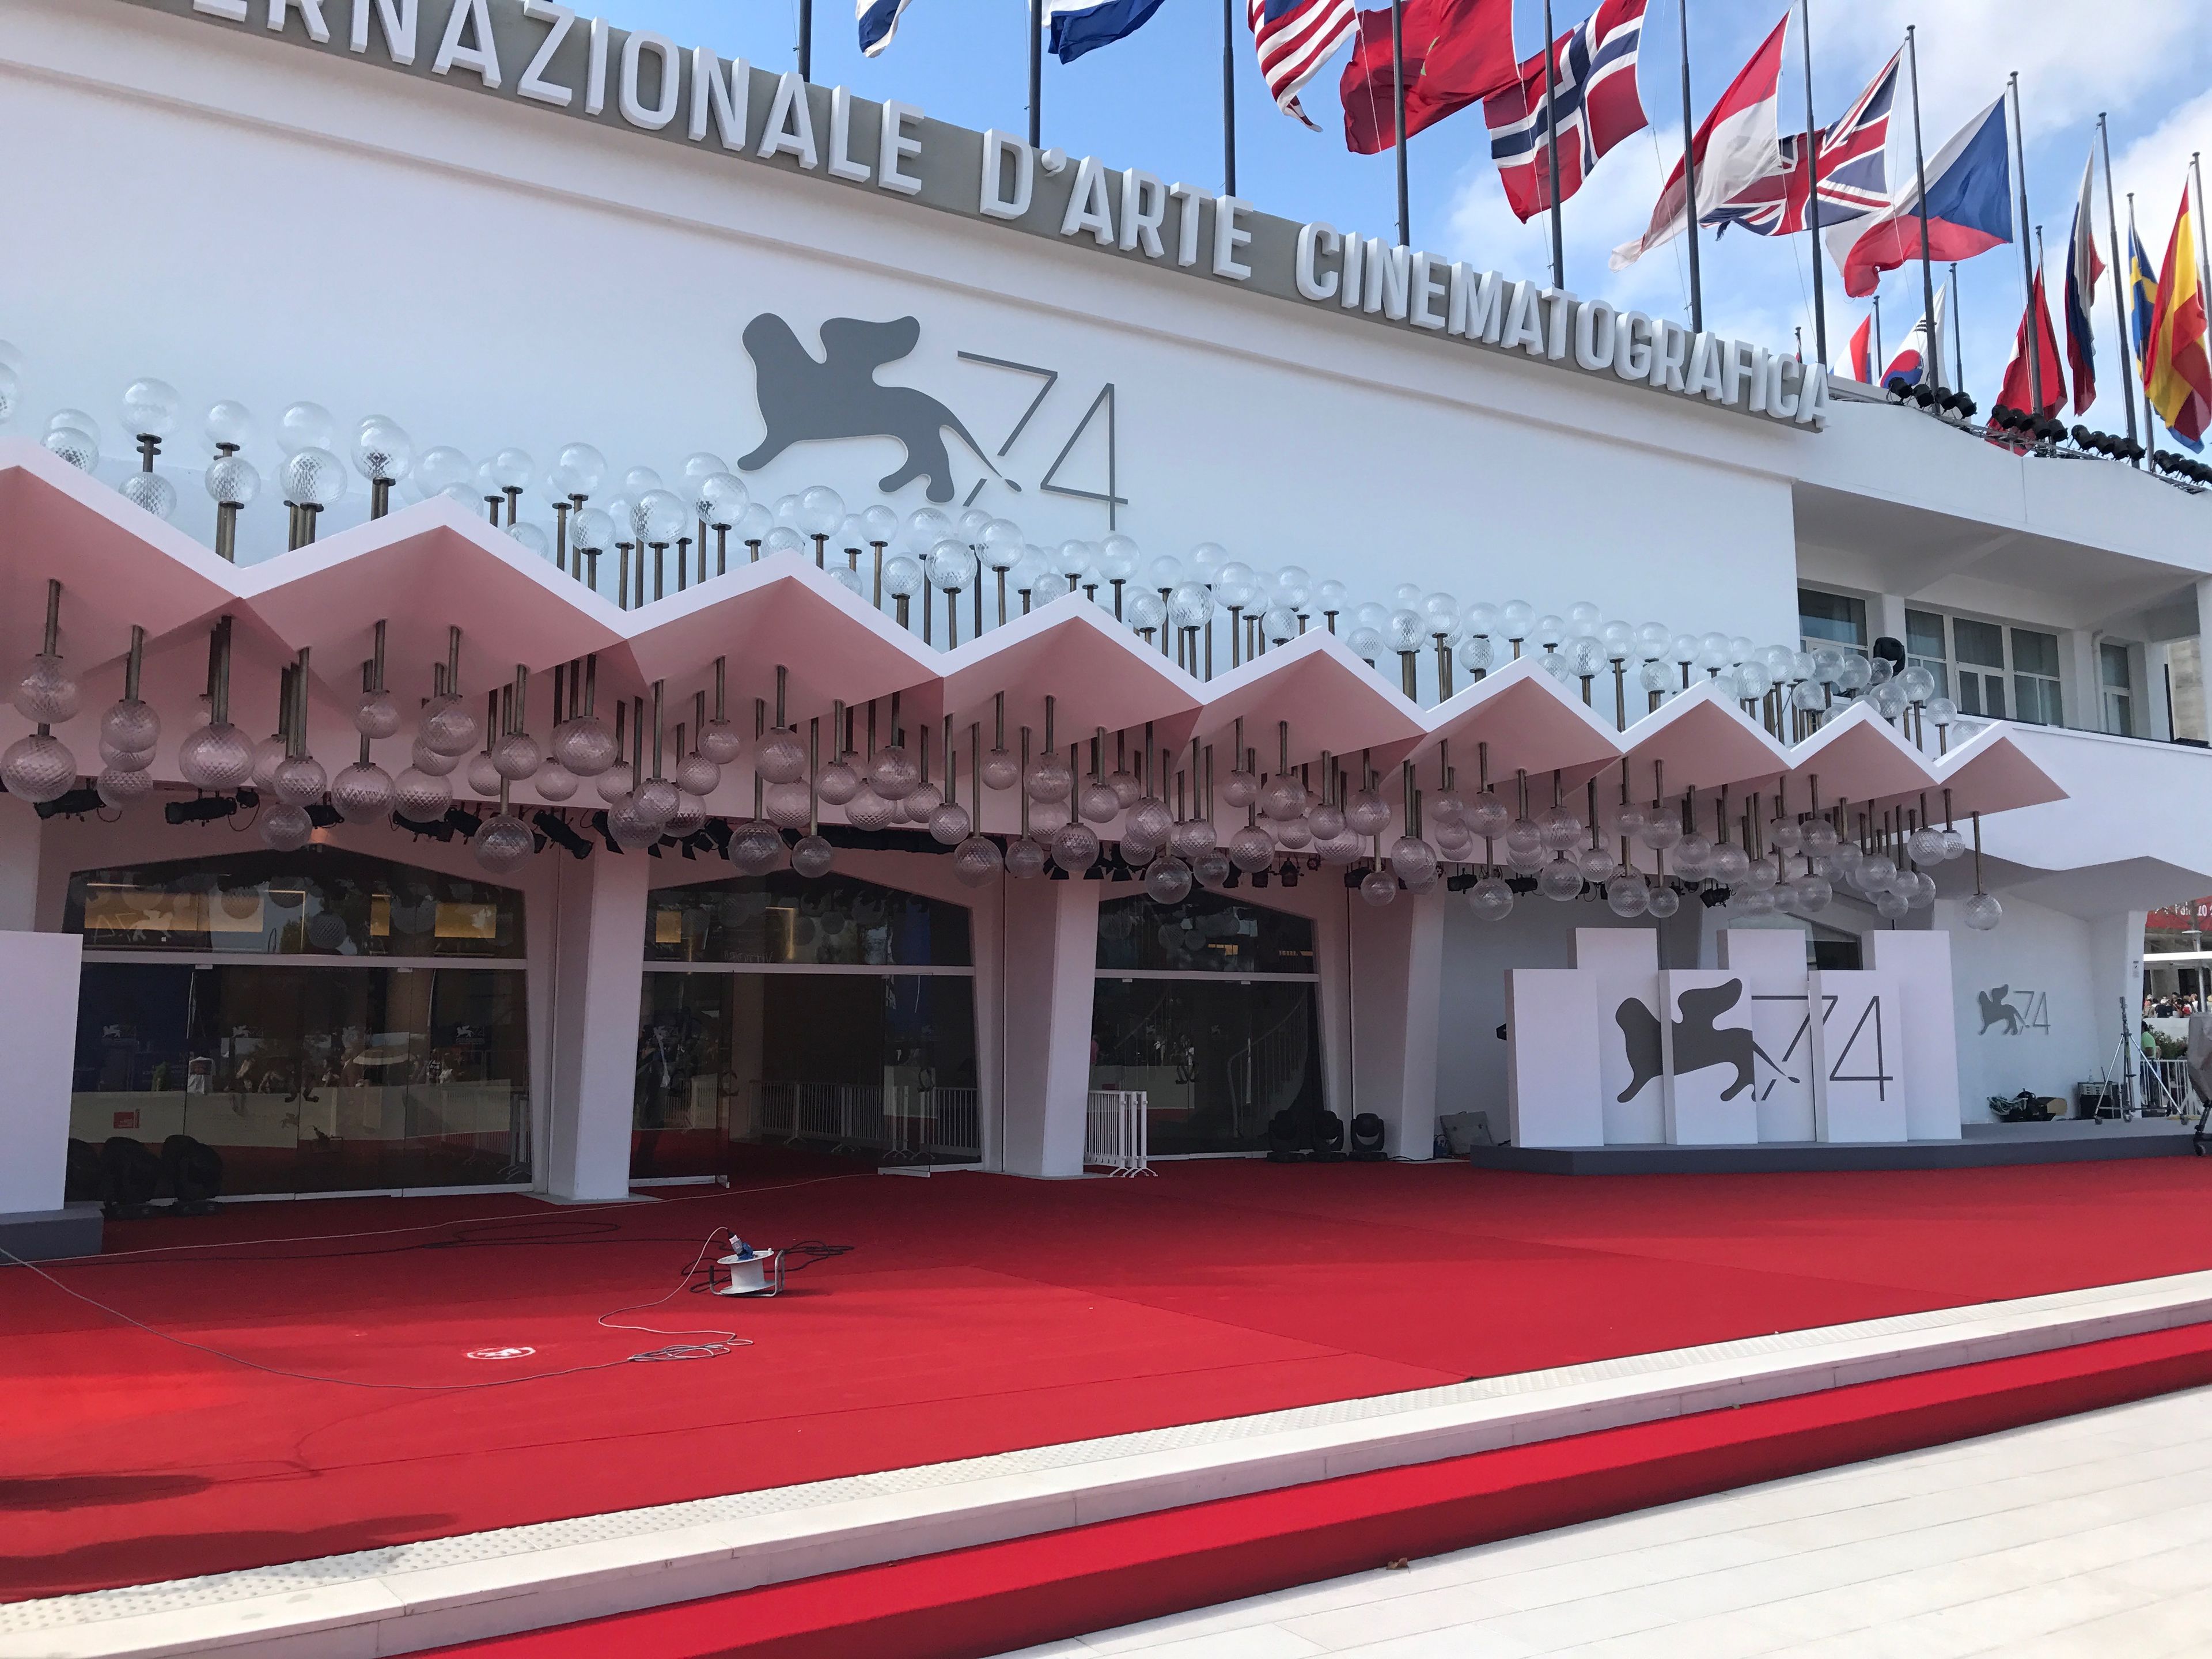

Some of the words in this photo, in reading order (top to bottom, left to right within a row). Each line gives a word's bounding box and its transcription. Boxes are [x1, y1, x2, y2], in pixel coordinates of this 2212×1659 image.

[193, 0, 925, 195] NAZIONALE
[980, 128, 1252, 281] D'ARTE
[1296, 222, 1831, 428] CINEMATOGRAFICA
[957, 351, 1128, 531] 74
[1751, 995, 1893, 1101] 74
[2013, 990, 2051, 1035] 74
